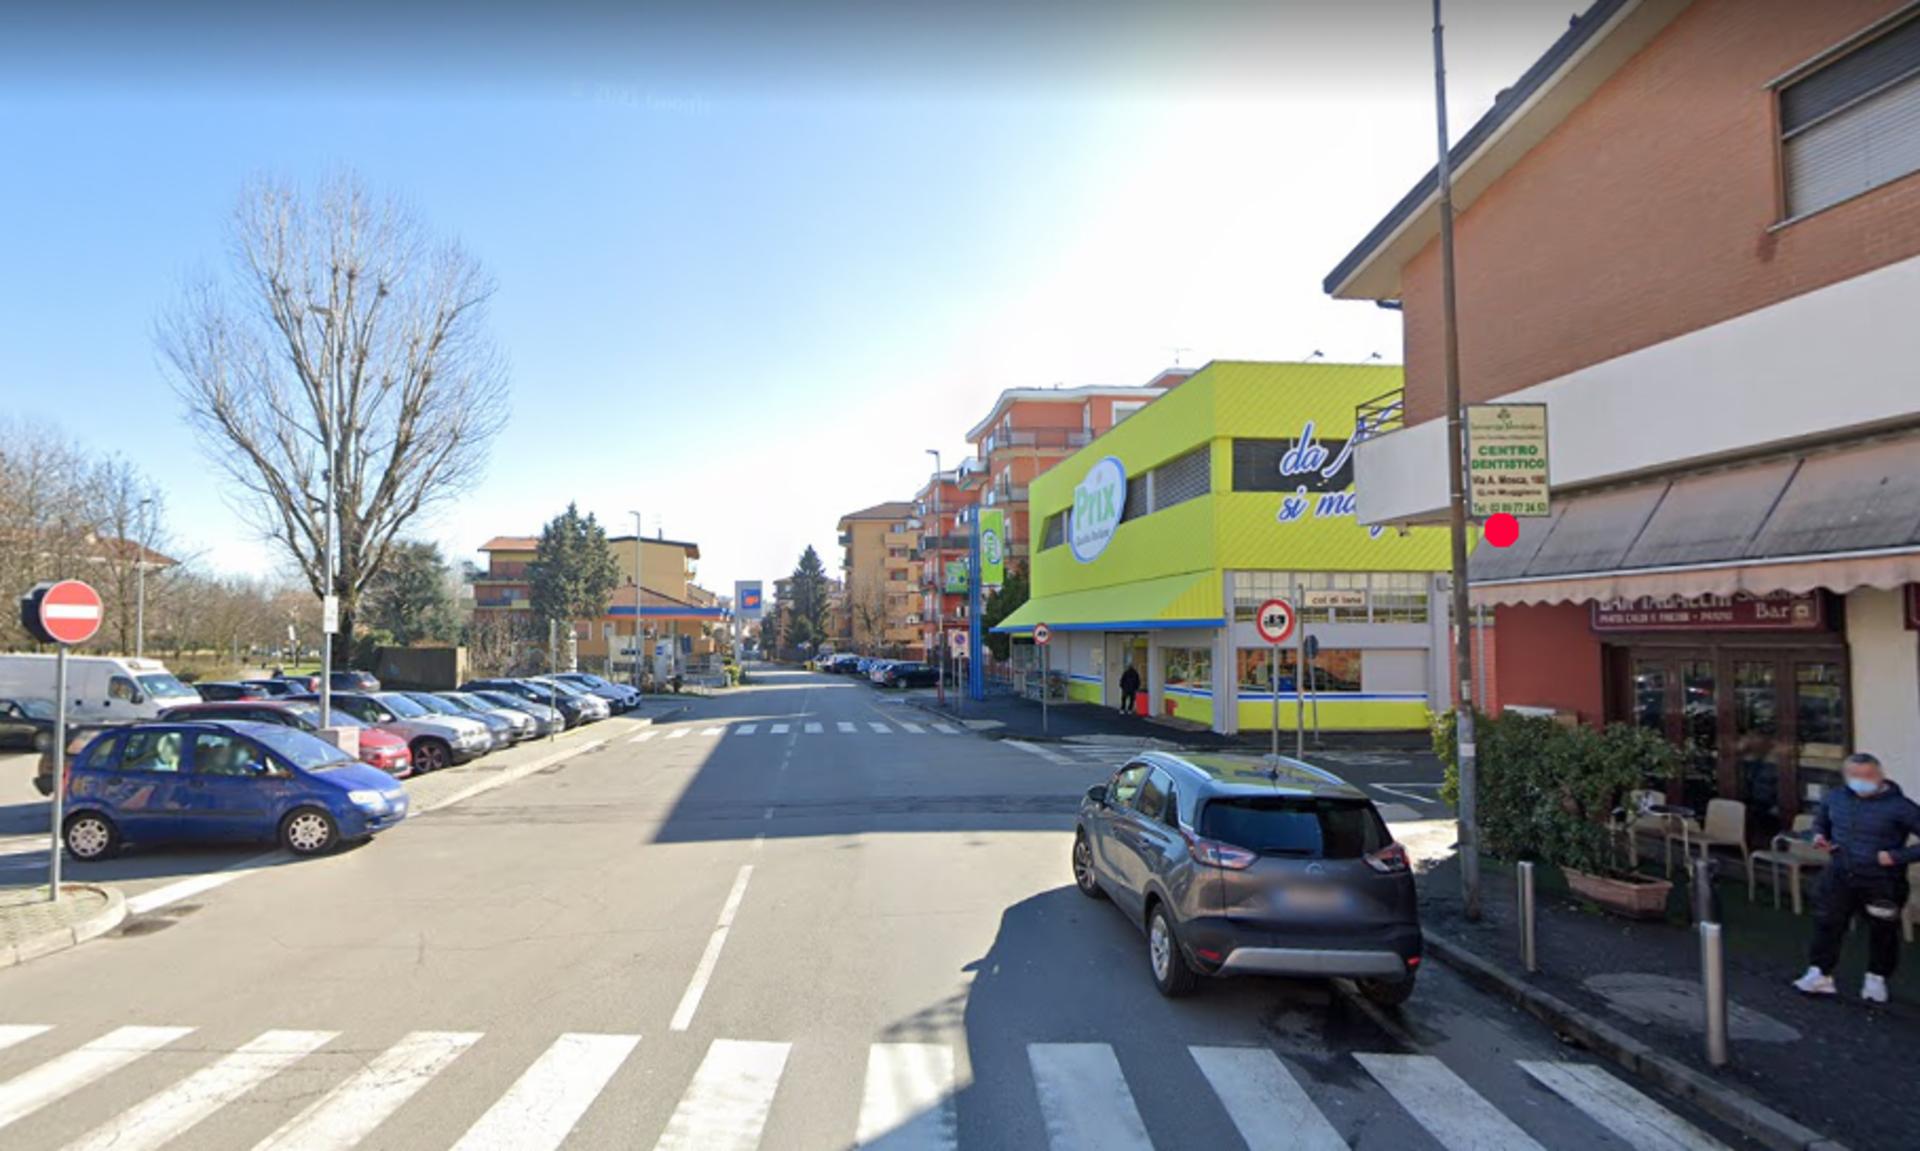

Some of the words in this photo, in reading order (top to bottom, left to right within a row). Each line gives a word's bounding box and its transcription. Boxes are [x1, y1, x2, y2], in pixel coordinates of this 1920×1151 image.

[1281, 421, 1329, 475] da
[1478, 445, 1538, 456] CENTRO
[1471, 459, 1545, 469] DENTISTICO
[1278, 486, 1308, 521] si
[1756, 602, 1790, 619] Bar
